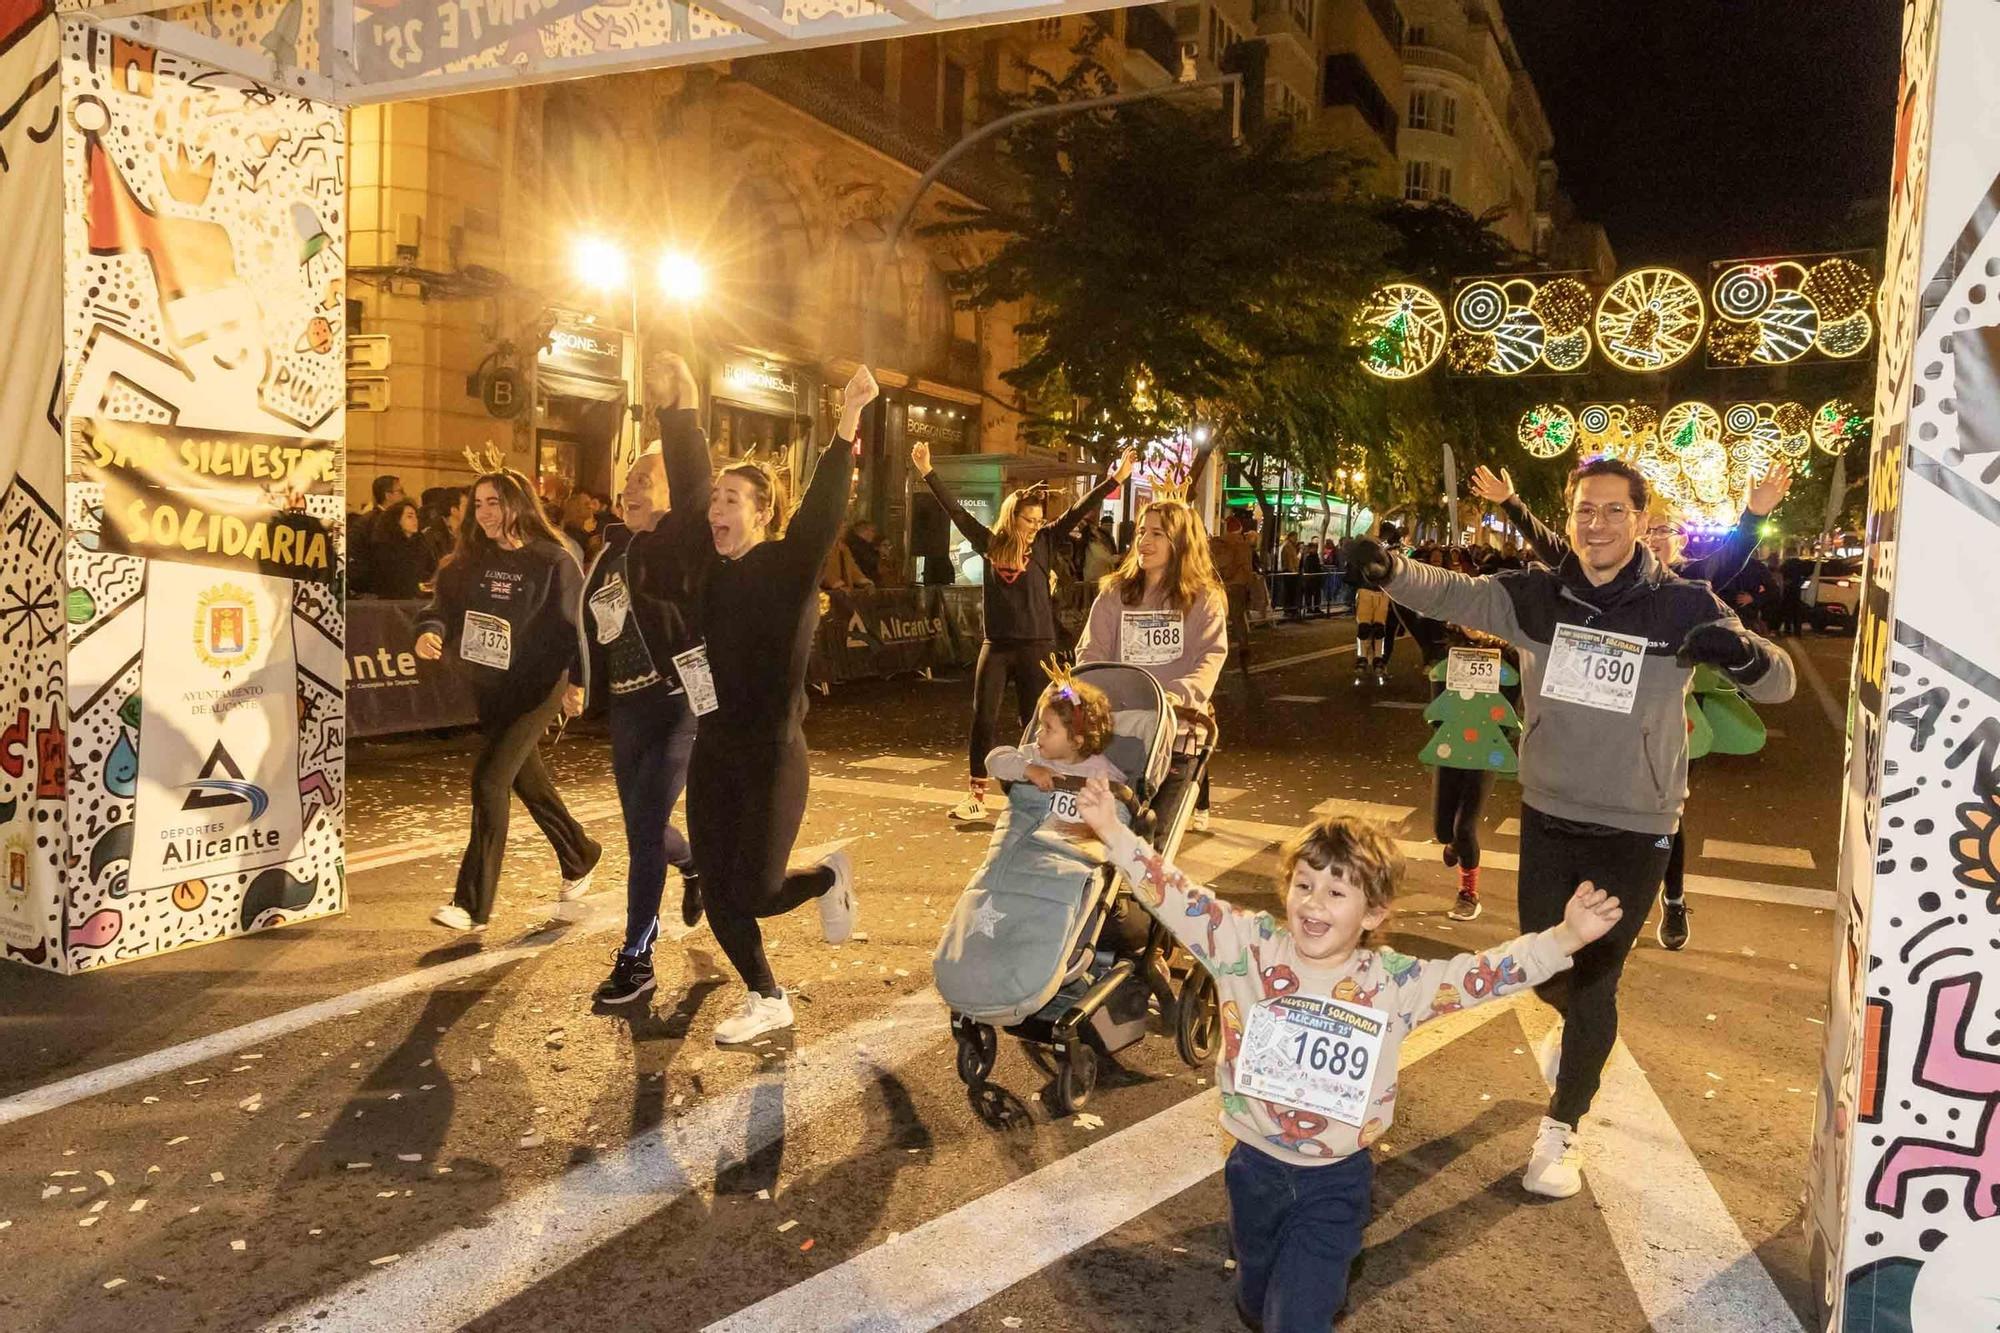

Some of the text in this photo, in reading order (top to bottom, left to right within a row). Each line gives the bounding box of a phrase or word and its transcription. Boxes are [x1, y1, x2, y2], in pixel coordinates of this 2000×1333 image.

[274, 365, 322, 409] RUN
[181, 438, 338, 482] SILVESTRE
[127, 499, 329, 569] SOLIDARIA
[485, 569, 523, 582] LONDON
[881, 616, 943, 640] Alicante
[1144, 628, 1180, 647] 1688
[481, 631, 509, 652] 1373
[1470, 662, 1493, 677] 553
[1583, 655, 1635, 685] 1690
[182, 686, 265, 702] AYUNTAMIENTO
[191, 700, 258, 715] DE ALICANTE
[161, 822, 226, 840] DEPORTES
[162, 828, 281, 865] Alicante
[1289, 1012, 1335, 1031] ALICANTE
[1327, 1006, 1378, 1034] SOLIDARIA
[1294, 1031, 1369, 1081] 1689
